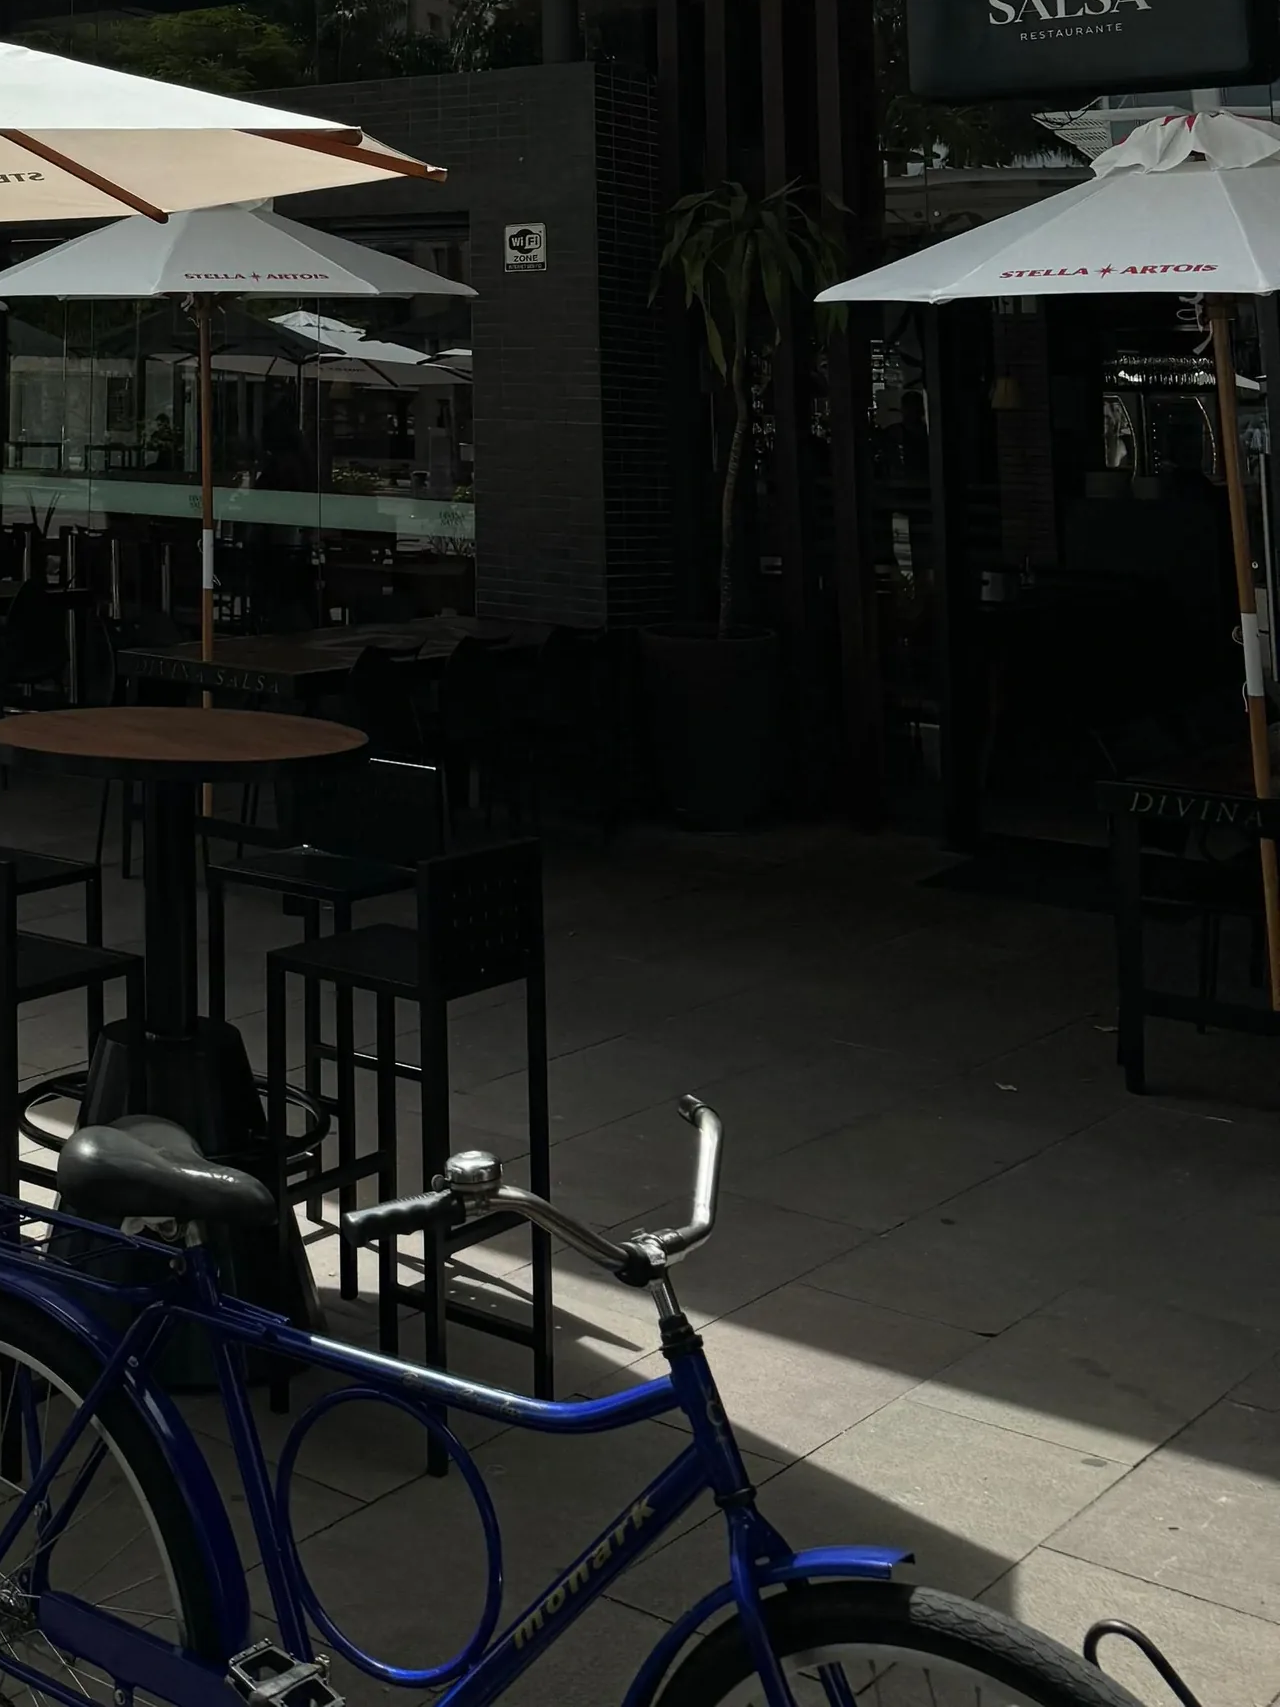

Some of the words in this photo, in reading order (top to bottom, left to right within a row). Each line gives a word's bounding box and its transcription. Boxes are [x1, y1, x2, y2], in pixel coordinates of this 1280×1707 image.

[1020, 22, 1123, 41] RESTAURANTE
[513, 254, 539, 263] ZONE
[266, 272, 330, 280] ARTOIS
[999, 267, 1089, 279] STELLA
[1120, 263, 1219, 275] ARTOIS
[215, 669, 279, 694] SALSA
[1129, 791, 1263, 828] DIVINA
[513, 1496, 657, 1650] monark
